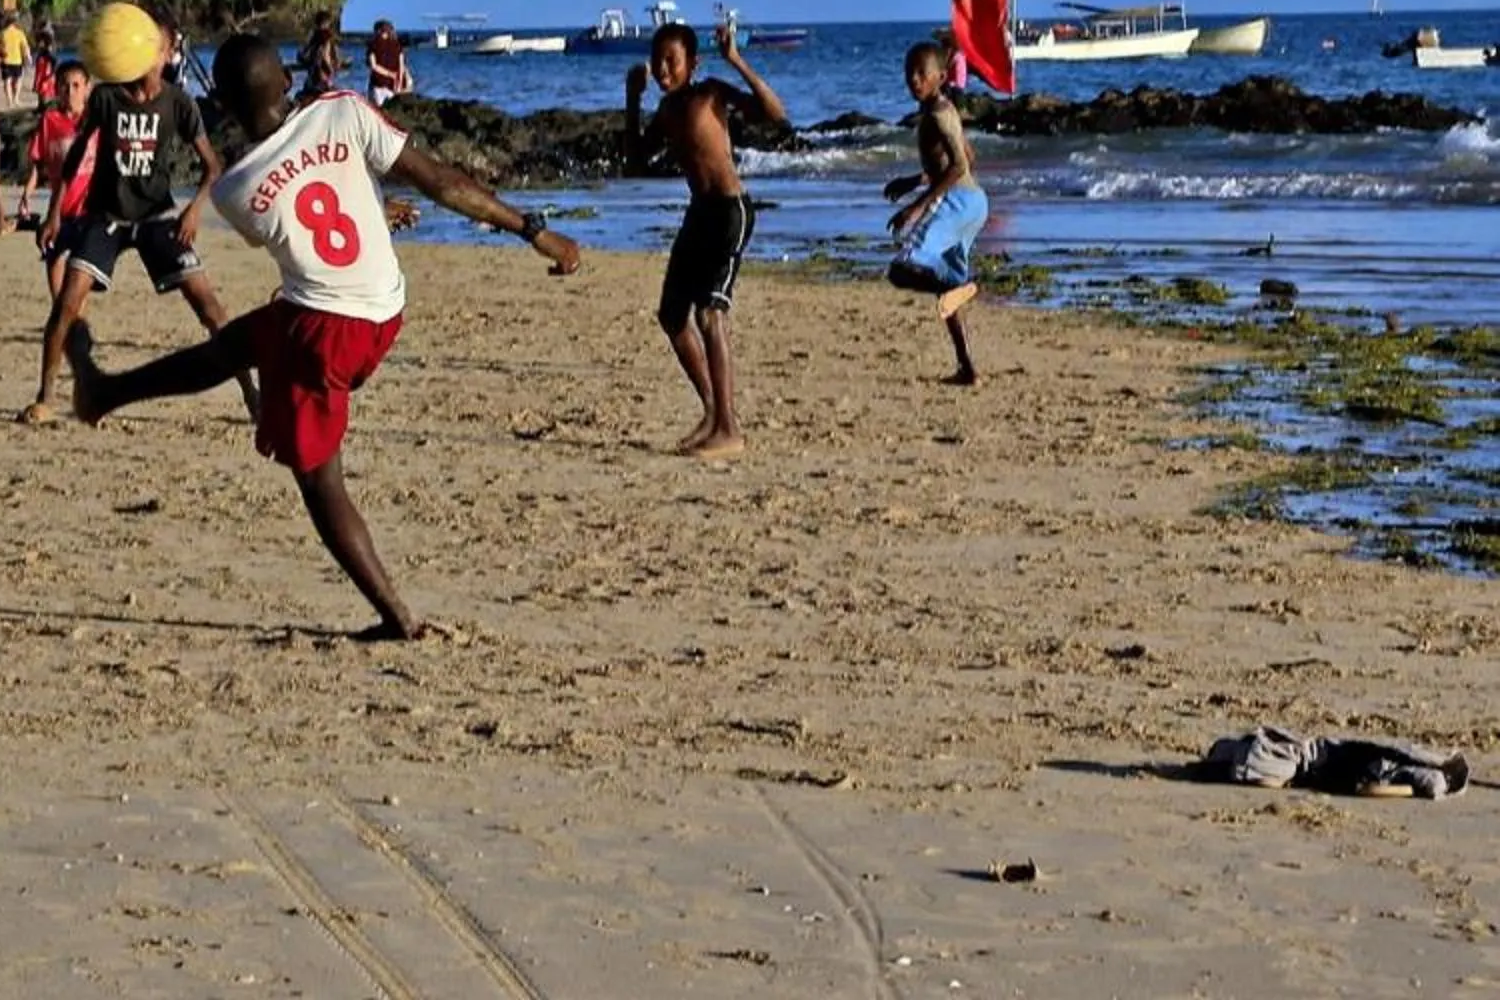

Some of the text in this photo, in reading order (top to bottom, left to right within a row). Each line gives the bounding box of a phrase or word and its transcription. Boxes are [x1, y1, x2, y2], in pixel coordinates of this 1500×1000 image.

[116, 111, 160, 140] CALI
[114, 149, 155, 177] LIFE
[250, 141, 350, 215] GERRARD
[294, 180, 361, 268] 8
